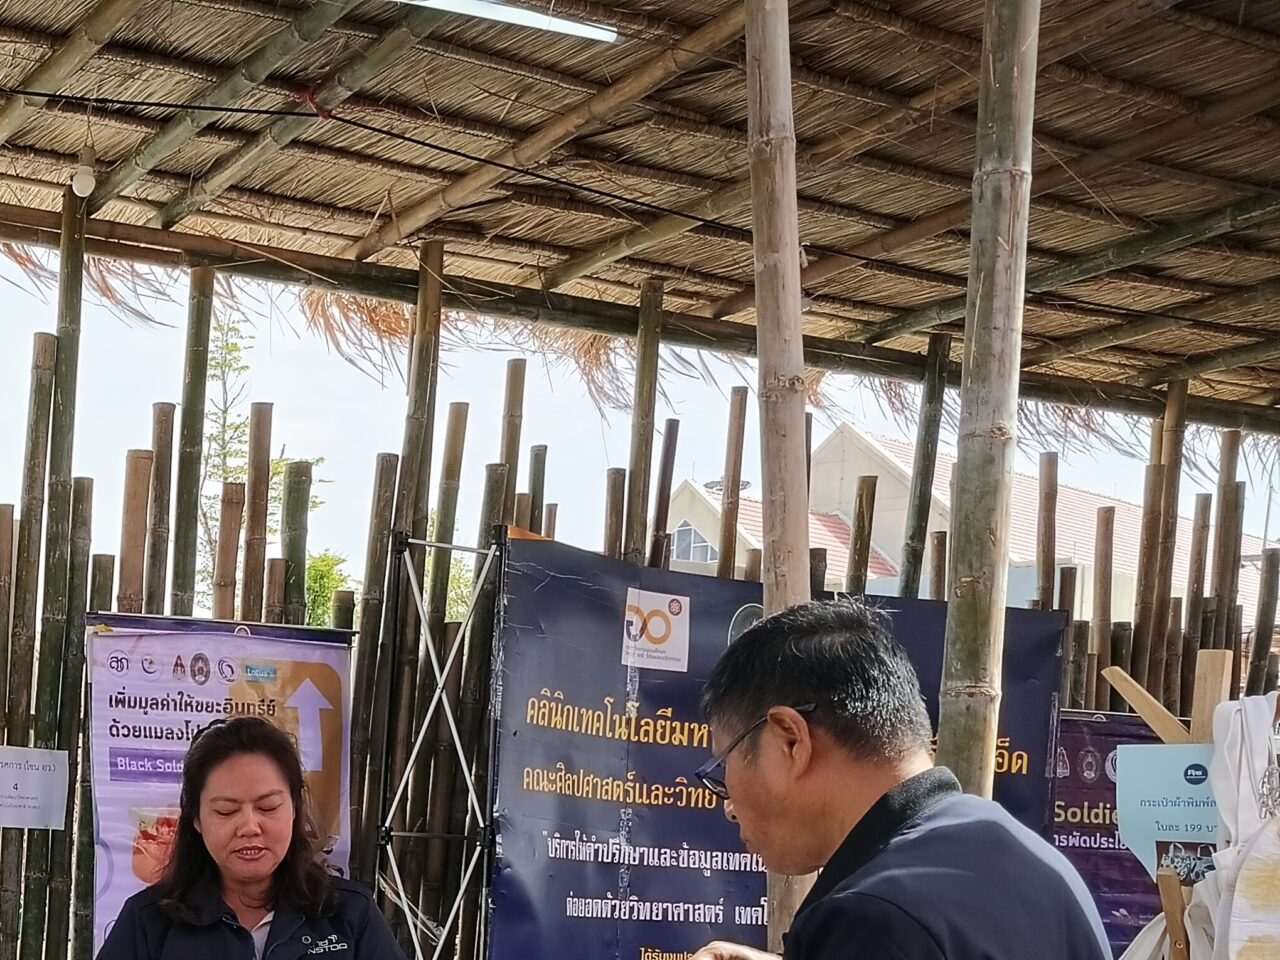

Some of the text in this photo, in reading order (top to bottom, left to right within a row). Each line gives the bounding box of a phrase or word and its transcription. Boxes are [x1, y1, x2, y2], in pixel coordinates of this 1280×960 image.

[109, 687, 276, 717] เพิ่มมูลค่าให้ขยะอินทรีย์
[526, 688, 1028, 774] คลินิกเทคโนโลยีมห อ็ด
[117, 757, 184, 773] Black Sold
[12, 783, 18, 791] 4
[523, 762, 717, 809] คณะศิลปศาสตร์และวิทย
[1140, 797, 1216, 808] กระเป๋าผ้าพิมพ์ล
[1155, 821, 1217, 833] ใบละ 199 บ
[566, 891, 769, 926] ต่อยอดด้วยวิทยาศาสตร์ เทคโ
[307, 943, 348, 955] NSTDA
